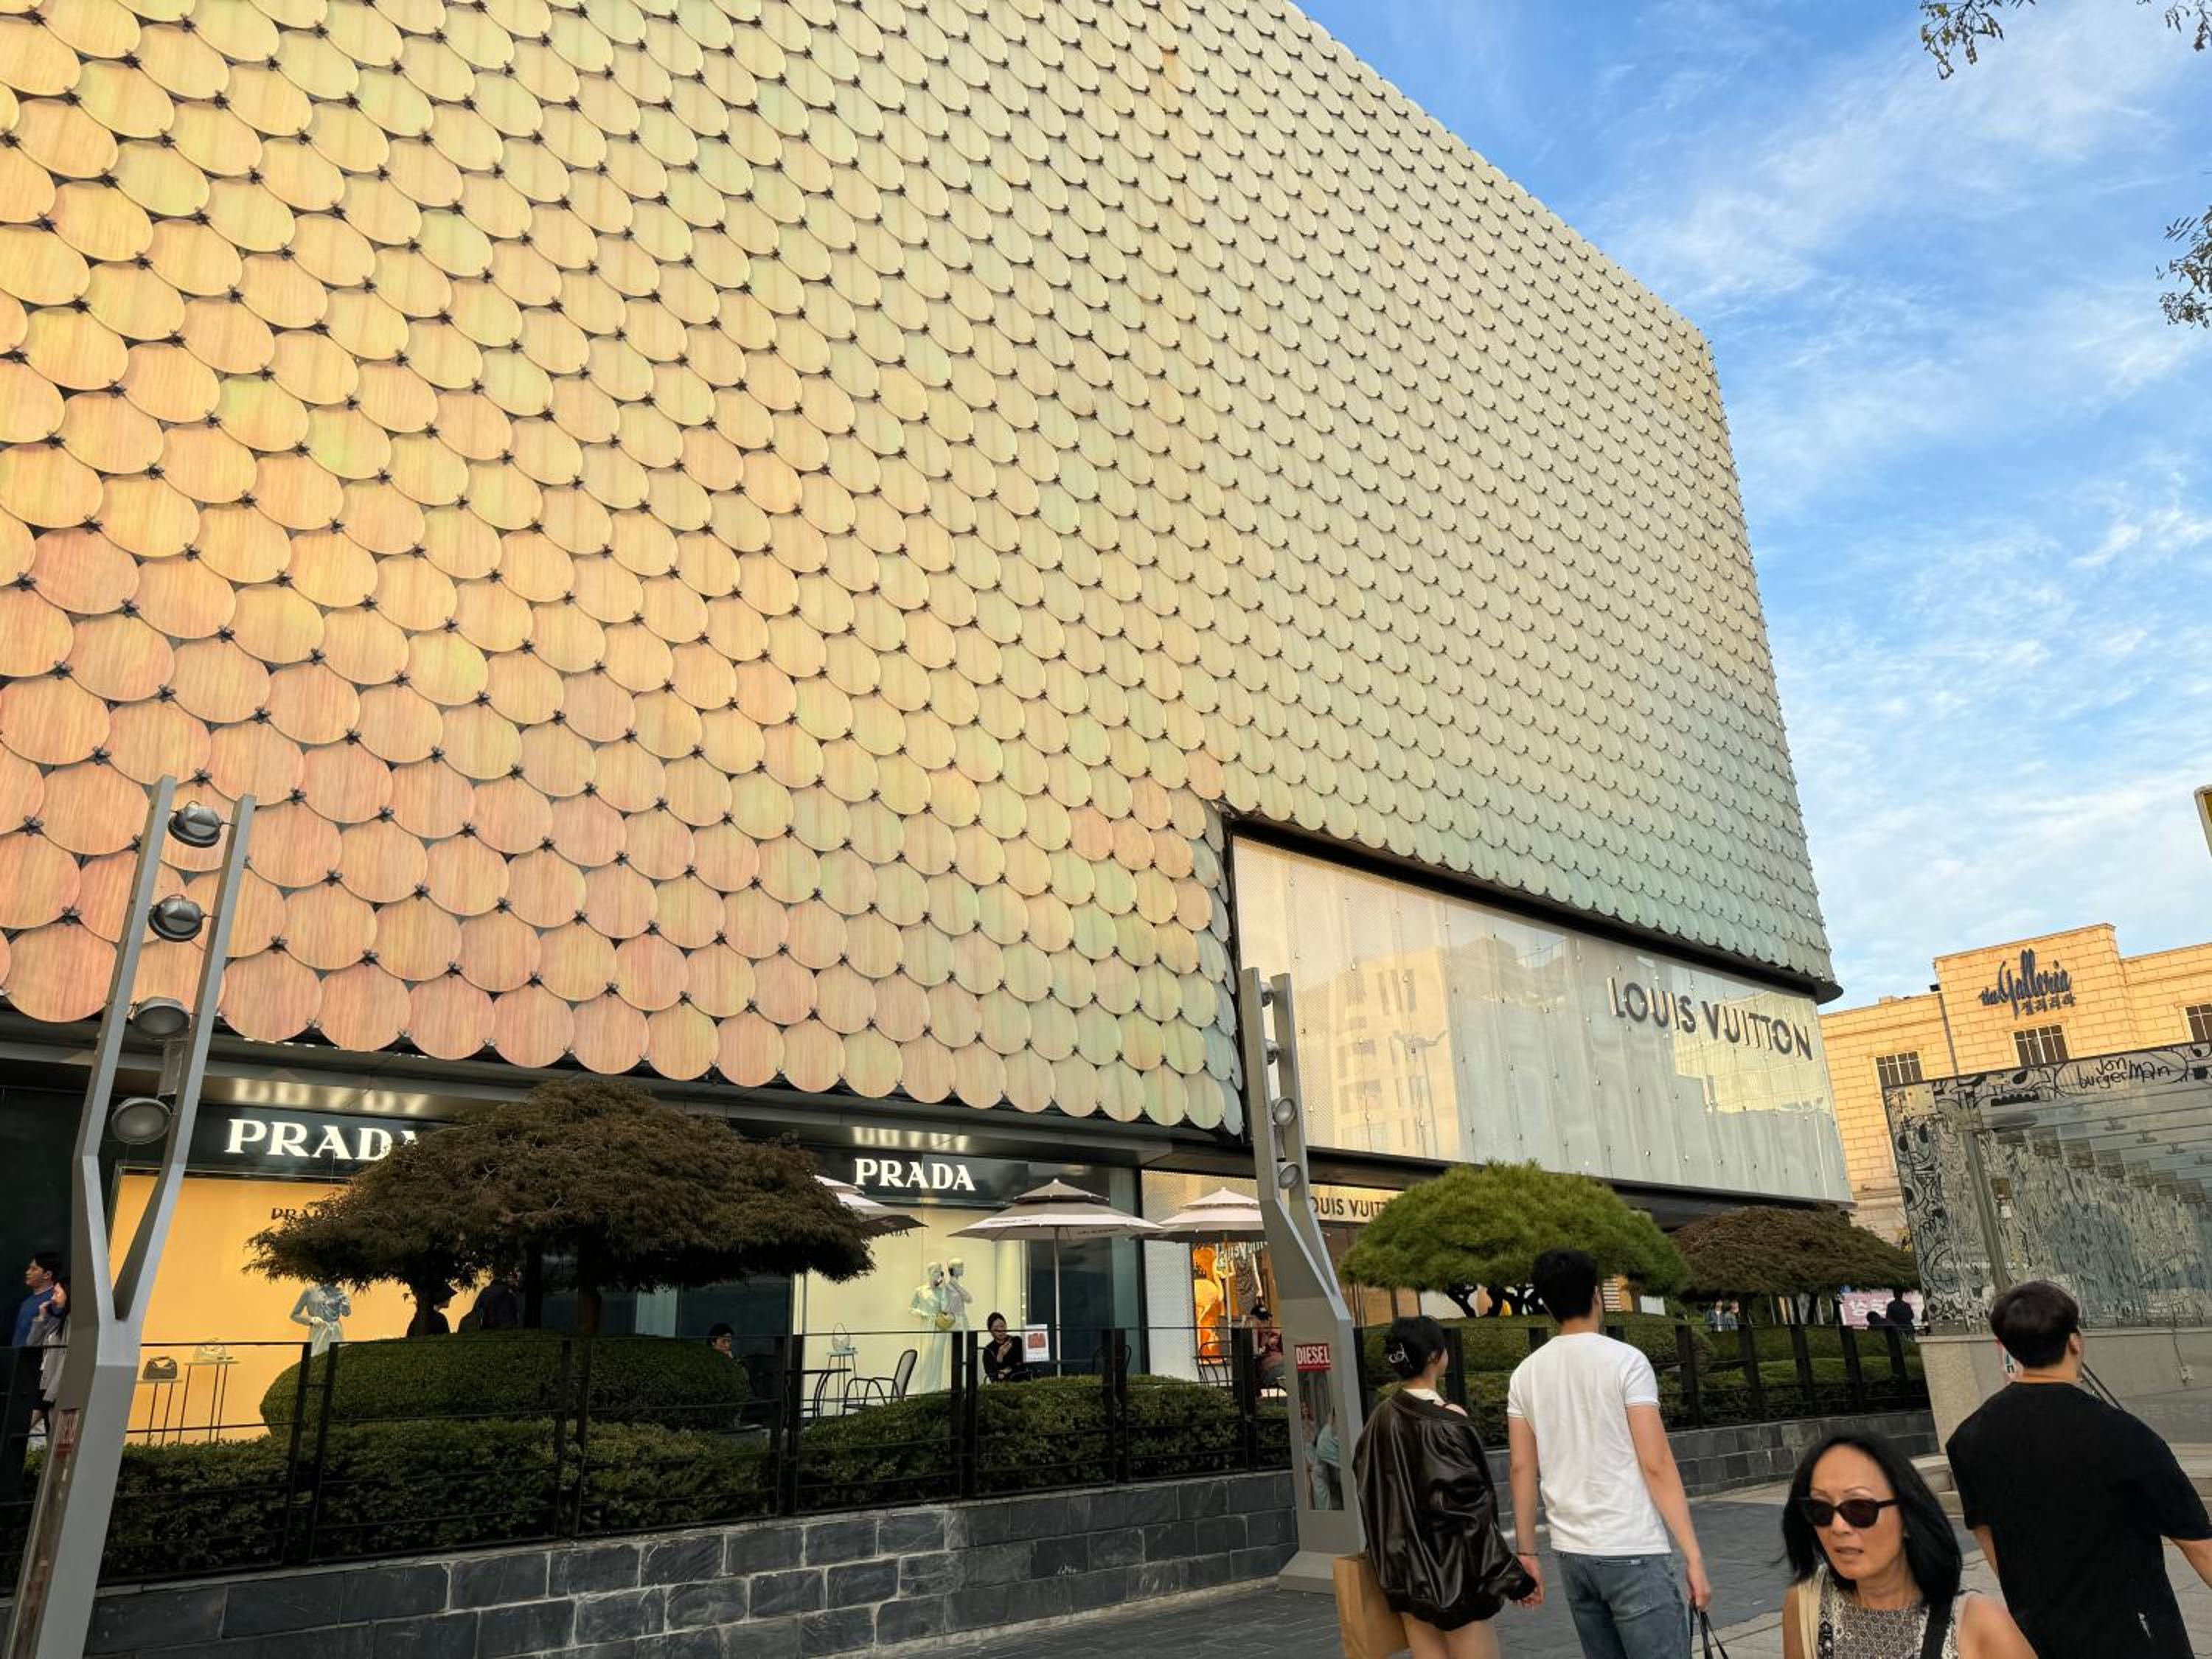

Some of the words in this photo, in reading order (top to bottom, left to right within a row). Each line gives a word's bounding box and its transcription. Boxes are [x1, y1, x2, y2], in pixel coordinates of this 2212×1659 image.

[1607, 977, 1697, 1033] LOUIS
[1701, 1001, 1813, 1061] VUITTON
[854, 1158, 976, 1191] PRADA
[1310, 1196, 1344, 1216] OUIS
[1349, 1199, 1388, 1217] VUIT
[1296, 1345, 1330, 1364] DIESEL
